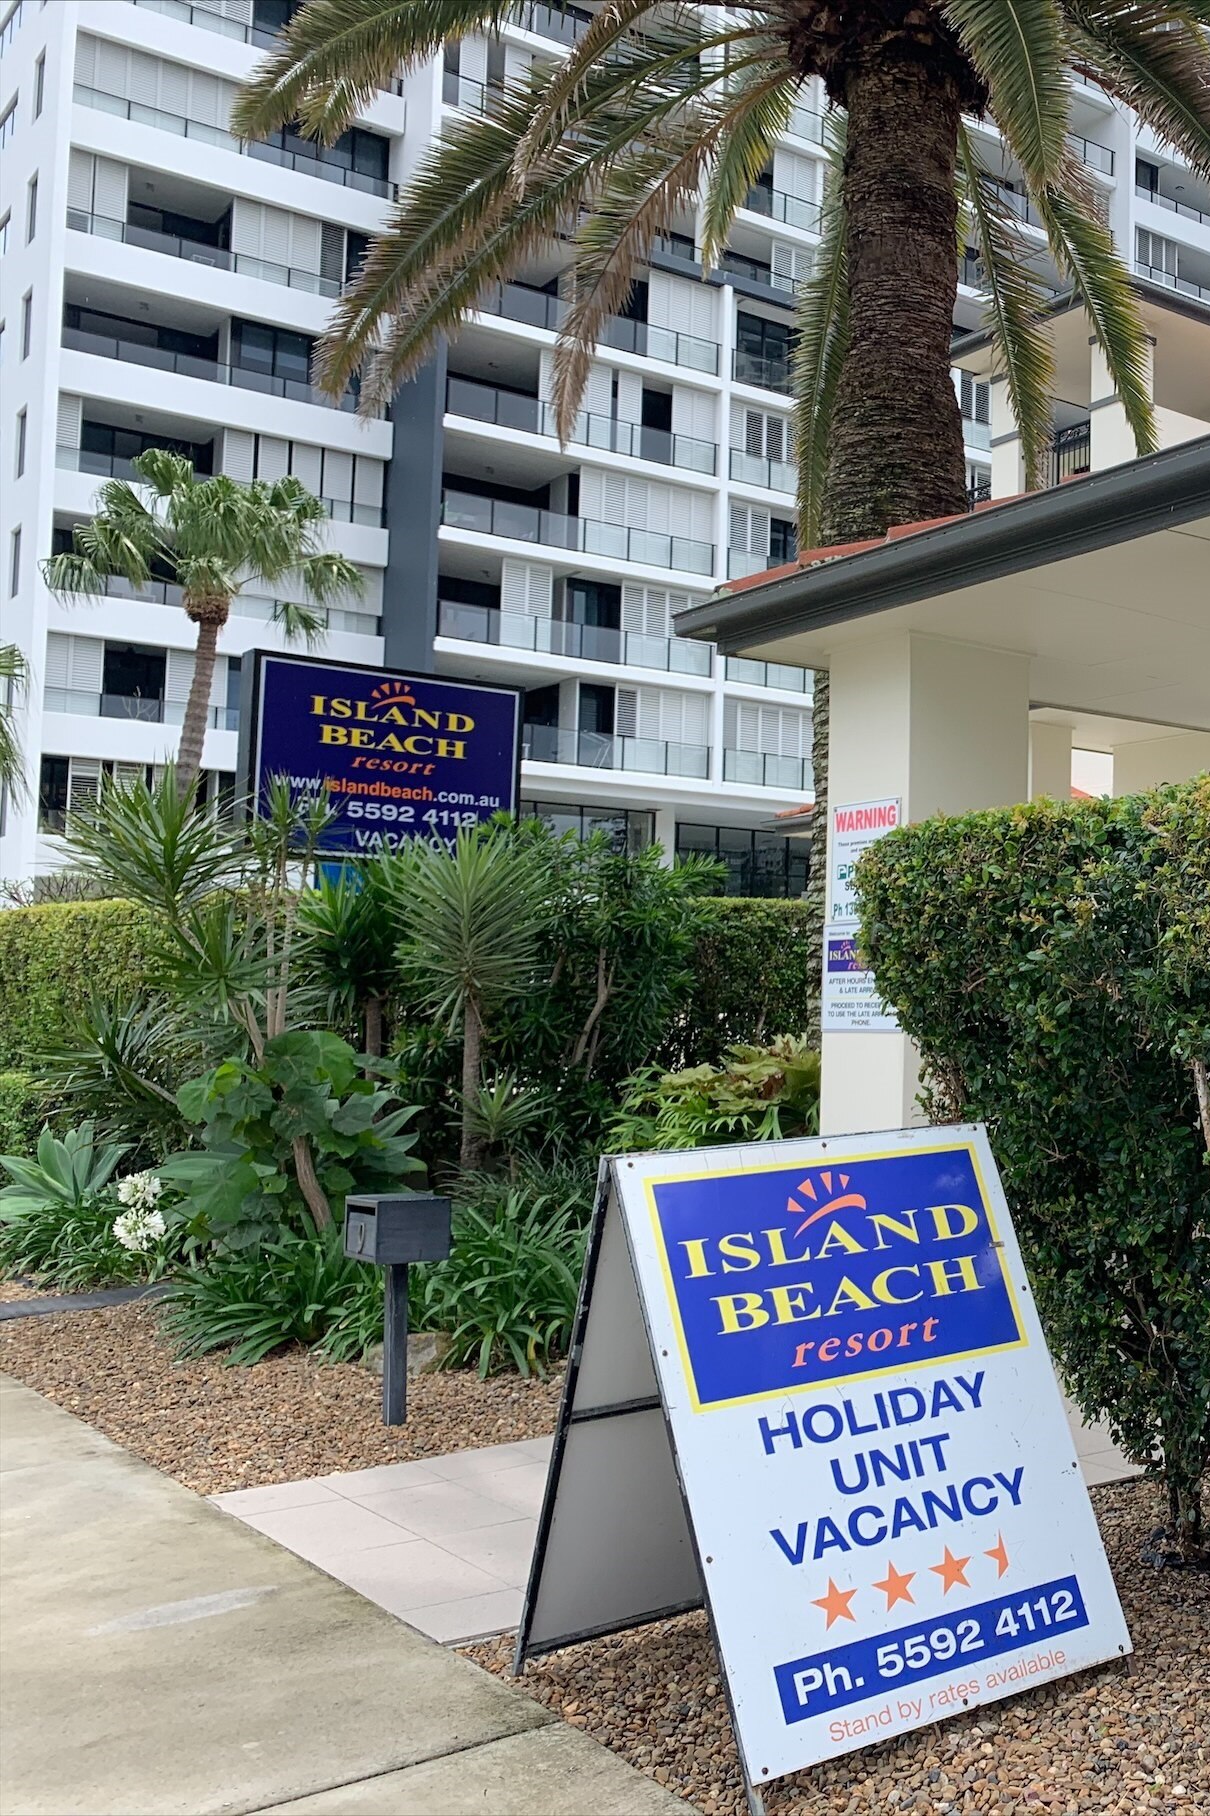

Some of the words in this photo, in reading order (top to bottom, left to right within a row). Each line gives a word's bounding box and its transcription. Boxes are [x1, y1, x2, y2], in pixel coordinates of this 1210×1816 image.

[310, 694, 475, 733] ISLAND
[319, 724, 467, 760] BEACH
[351, 755, 436, 776] resort
[347, 801, 415, 823] 5592
[422, 809, 478, 828] 4112
[836, 805, 896, 832] WARNING
[833, 903, 843, 917] Ph
[829, 950, 860, 961] ISLAN
[678, 1204, 980, 1280] ISLAND
[709, 1254, 986, 1336] BEACH
[791, 1316, 939, 1368] resort
[757, 1371, 986, 1455] HOLIDAY
[830, 1433, 950, 1495] UNIT
[769, 1467, 1025, 1566] VACANCY
[792, 1662, 864, 1706] Ph.
[875, 1620, 985, 1678] 5592
[994, 1589, 1078, 1638] 4112
[829, 1706, 892, 1743] Stand
[898, 1697, 922, 1721] by
[929, 1680, 981, 1712] rates
[986, 1648, 1066, 1690] available
